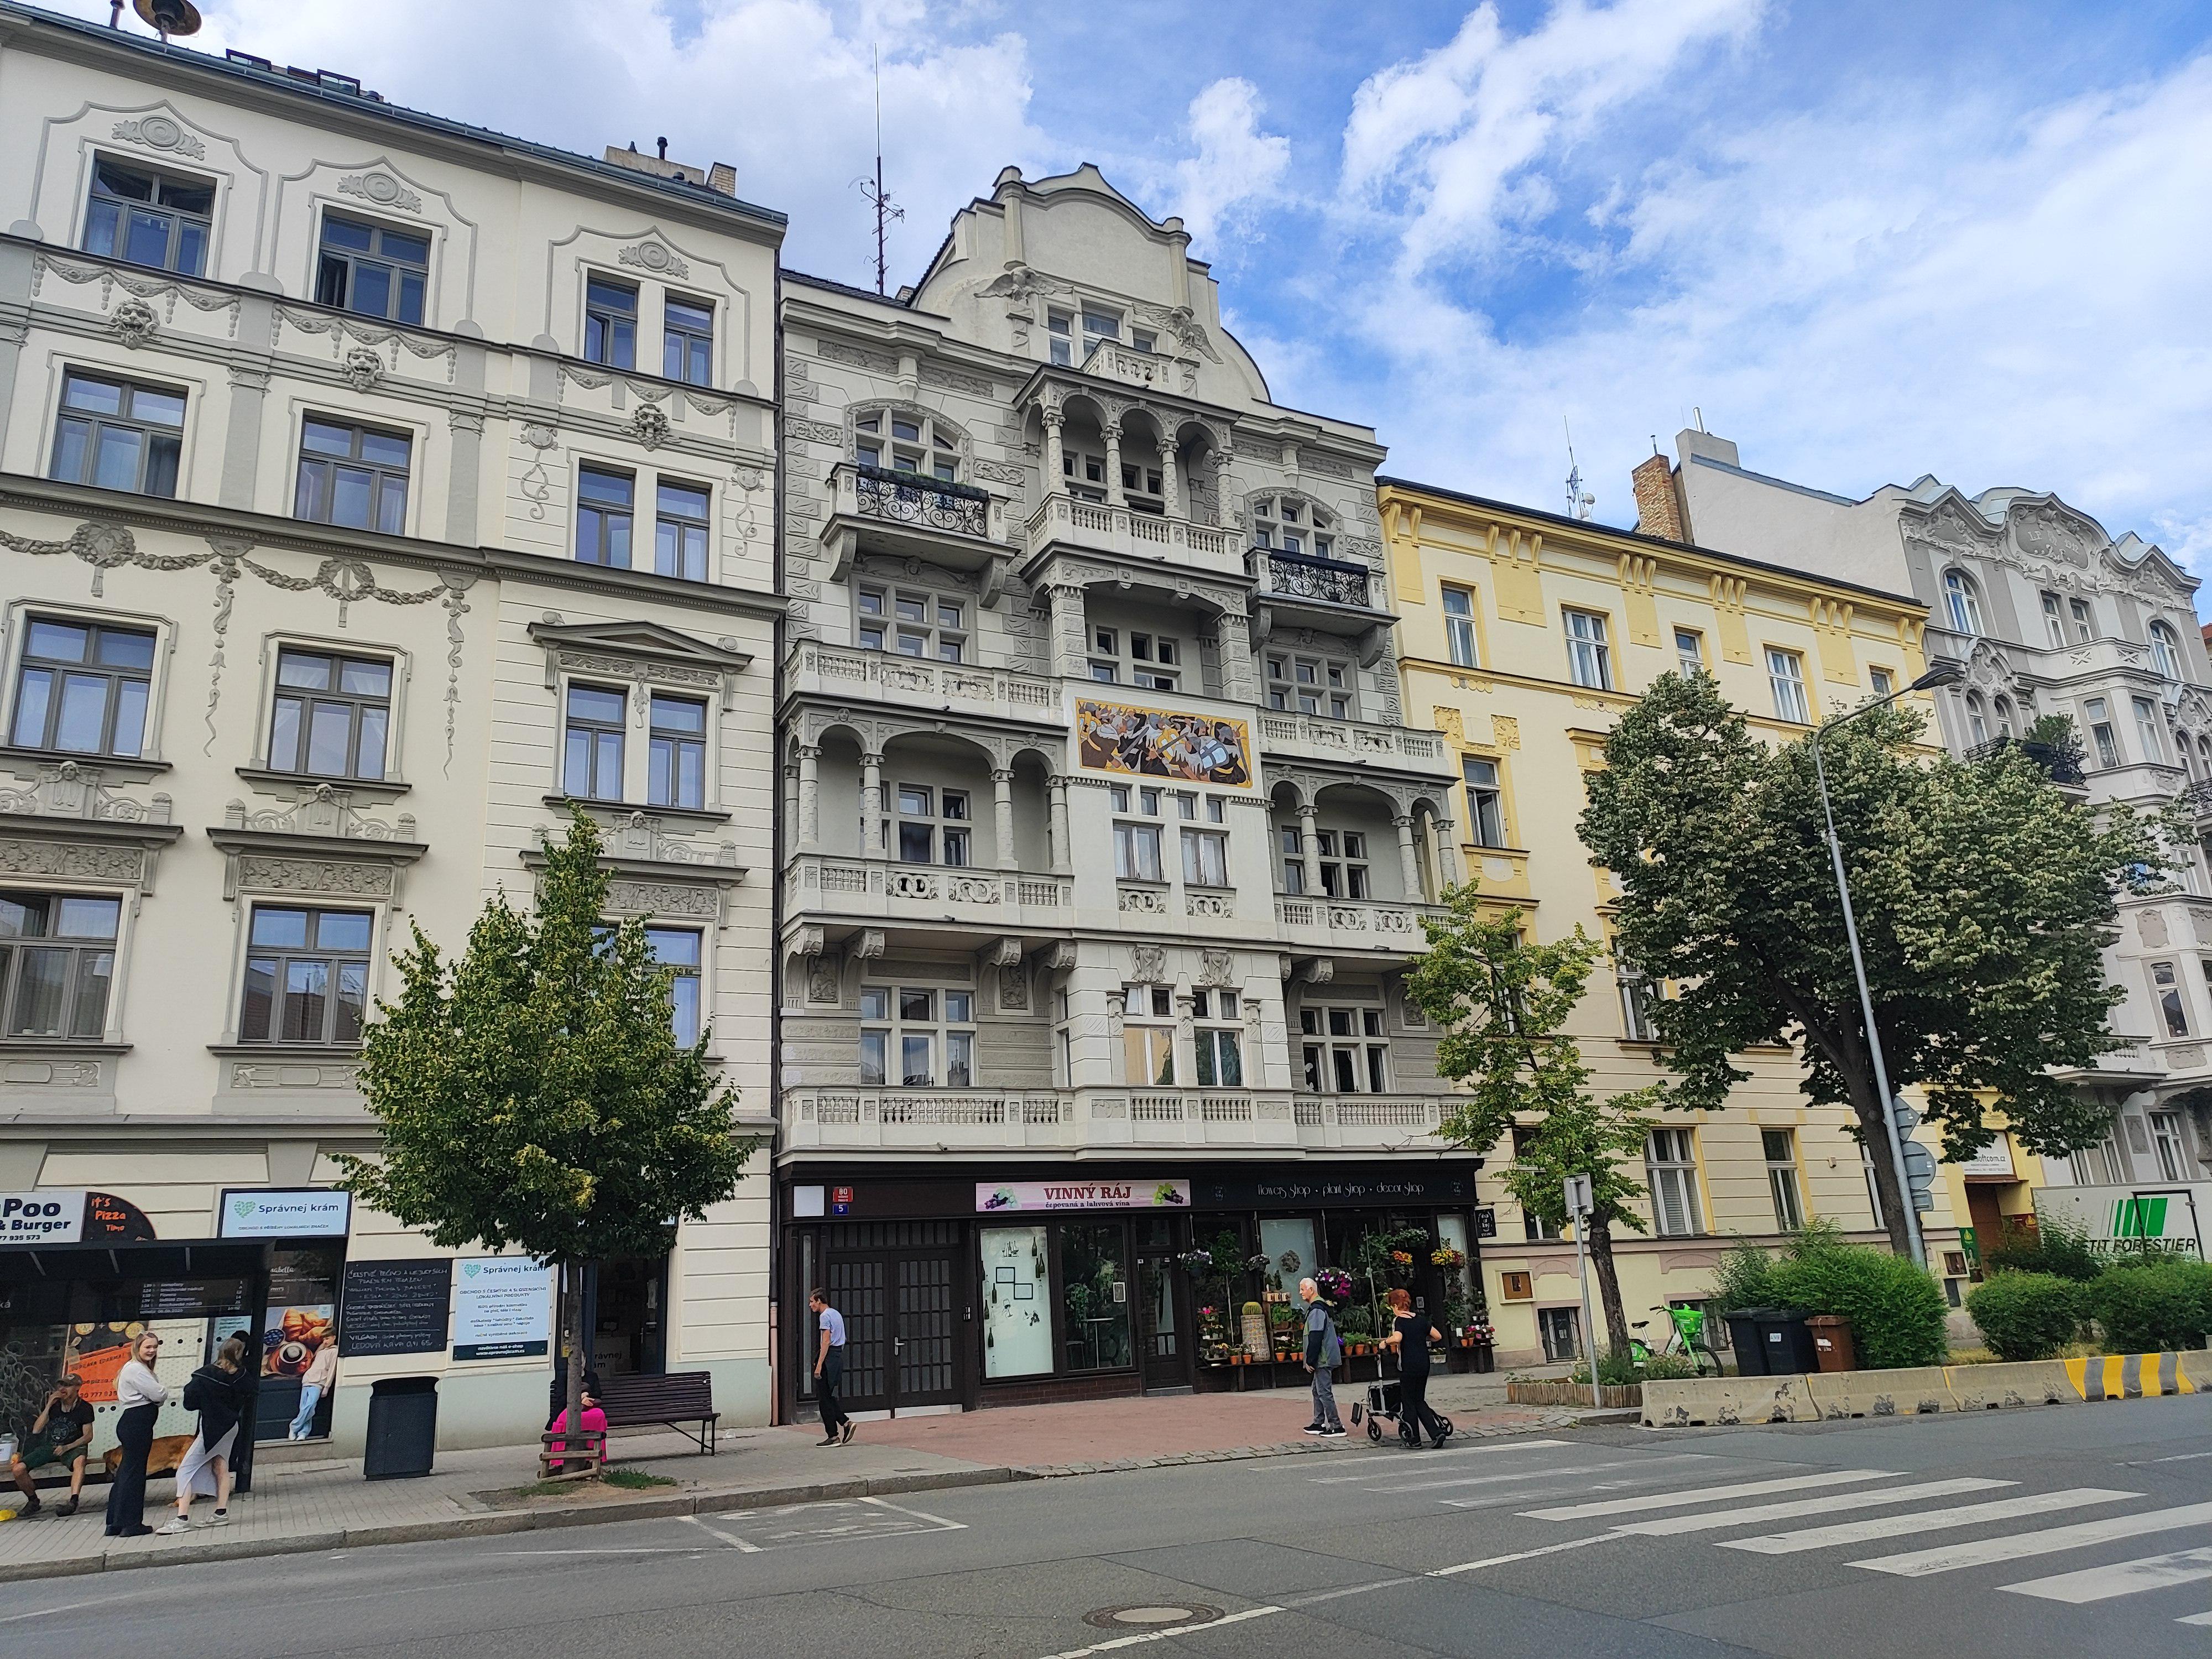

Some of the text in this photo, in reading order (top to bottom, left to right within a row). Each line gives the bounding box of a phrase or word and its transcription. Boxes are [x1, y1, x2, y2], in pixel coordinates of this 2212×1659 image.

[1043, 1182, 1131, 1200] VINNÝ RÁJ
[1288, 1183, 1311, 1198] shop
[1343, 1182, 1365, 1197] shop
[1376, 1182, 1401, 1193] decor
[1402, 1181, 1423, 1196] shop
[0, 1198, 61, 1217] Poo
[259, 1203, 338, 1214] Správnej krám
[95, 1211, 126, 1220] Pizza
[12, 1219, 71, 1233] Burger
[2113, 1238, 2196, 1253] FORESTIER
[483, 1265, 521, 1274] Správnej
